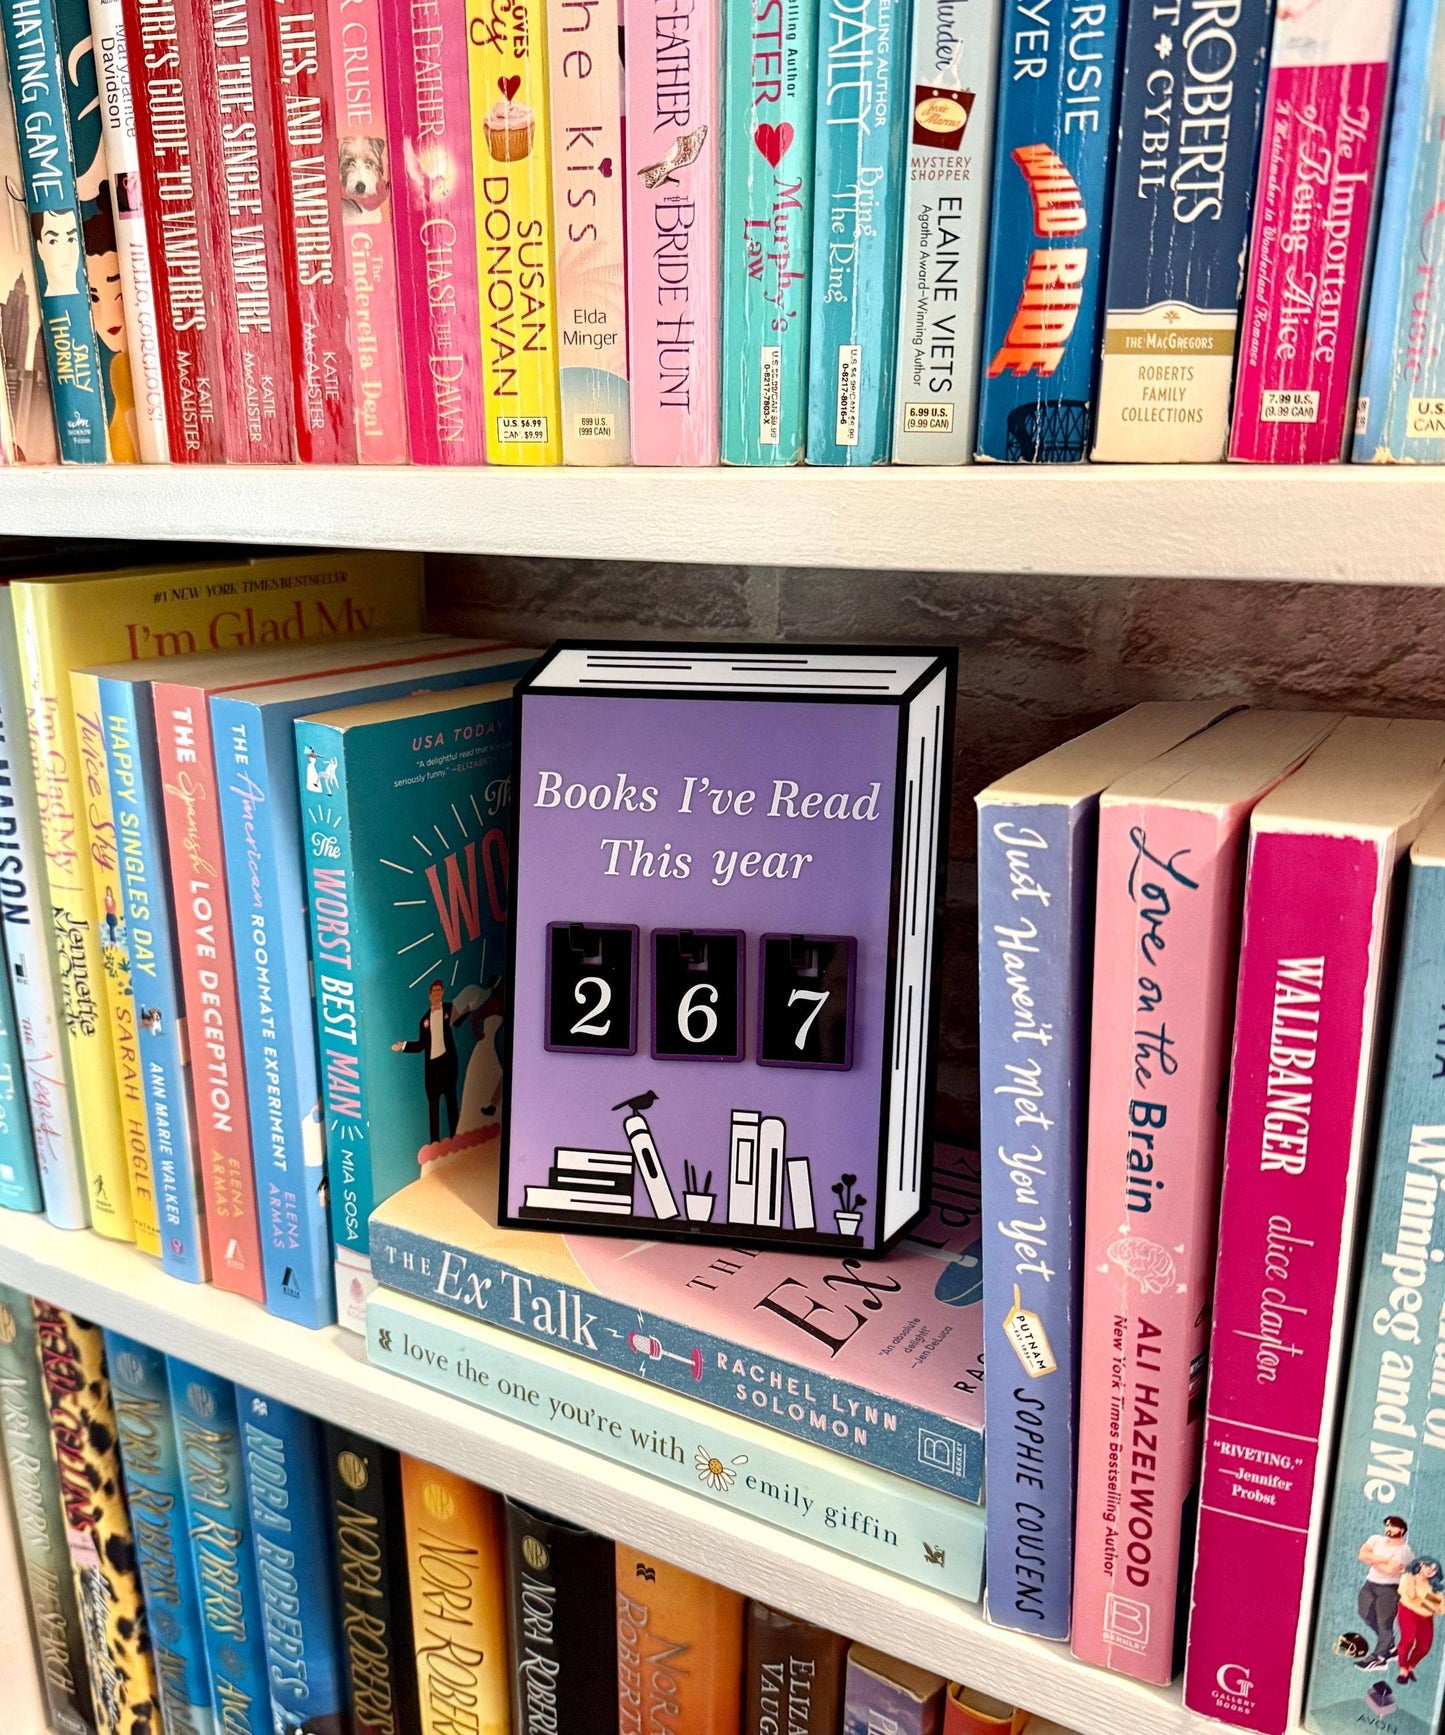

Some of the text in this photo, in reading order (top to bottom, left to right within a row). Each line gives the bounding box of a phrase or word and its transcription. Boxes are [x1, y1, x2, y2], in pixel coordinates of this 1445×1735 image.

[101, 37, 121, 129] Davidson
[341, 22, 373, 127] CRUSIE
[787, 48, 798, 98] Author
[875, 57, 889, 127] AUTHOR
[24, 110, 64, 203] GAME
[910, 169, 971, 181] SHOPPER
[911, 156, 972, 168] MYSTERY
[1137, 69, 1175, 199] CYBIL
[147, 78, 208, 332] GUIDE TO VAMPIRES
[217, 56, 272, 334] THE SINGLE VAMPIRE
[284, 95, 334, 287] AND VAMPIRES
[565, 125, 613, 242] kiss
[854, 166, 884, 237] Bring
[1010, 143, 1087, 237] WILD
[743, 219, 771, 282] Law
[764, 177, 805, 332] Murphy's
[824, 184, 860, 305] The Ring
[1276, 104, 1332, 362] of Being Alice
[1316, 104, 1370, 363] The Importance
[483, 177, 518, 397] DONOVAN
[517, 219, 548, 352] SUSAN
[573, 309, 607, 325] Elda
[654, 201, 695, 414] BRIDE HUNT
[913, 204, 934, 387] Agatha Author
[929, 197, 963, 393] ELAINE VIETS
[985, 247, 1088, 378] RIDE
[48, 310, 71, 386] THORNE
[72, 338, 94, 392] SALLY
[350, 232, 384, 437] Cinderella Deal
[420, 218, 465, 443] CHASE DAWN
[563, 331, 617, 350] Minger
[1125, 336, 1143, 348] THE
[1250, 305, 1267, 367] Romance
[196, 377, 214, 424] KATIE
[261, 376, 276, 418] KATIE
[322, 351, 341, 401] KATIE
[909, 408, 948, 418] 6.99 U.S.
[1121, 407, 1204, 423] COLLECTIONS
[1138, 366, 1194, 380] ROBERTS
[1142, 387, 1186, 402] FAMILY
[521, 419, 542, 428] $6.99
[524, 430, 544, 440] $9.99
[907, 418, 949, 429] (9.99 CAN)
[172, 571, 348, 600] NEW YORK TIMES BESTSELLER
[125, 601, 305, 660] I'm Glad
[393, 775, 426, 788] seriously
[412, 732, 445, 751] USA
[426, 749, 474, 767] delightful read
[76, 711, 118, 875] Twice Shy
[533, 770, 659, 813] Books
[677, 776, 756, 816] I've
[766, 779, 882, 821] Read
[106, 715, 157, 978] HAPPY SINGLES DAY
[600, 838, 813, 887] This year
[171, 706, 232, 1133] THE LOVE DECEPTION
[229, 724, 287, 1172] THE American ROOMMATE EXPERIMENT
[65, 910, 96, 1037] Jennette
[311, 831, 362, 1119] The WORST BEST MAN
[569, 976, 831, 1050] 2 6 7
[116, 1006, 141, 1101] SARAH
[993, 822, 1056, 1282] Just Haven't Met You Yet
[1126, 826, 1199, 1214] Love on the Brain
[1260, 955, 1325, 1175] WALLBANGER
[128, 1118, 152, 1202] HOGLE
[150, 1061, 181, 1226] ANN MARIE WALKER
[211, 1150, 230, 1218] ARMAS
[229, 1157, 244, 1218] ELENA
[268, 1183, 285, 1249] ARMAS
[284, 1191, 300, 1250] ELENA
[340, 1149, 360, 1241] MIA SOSA
[384, 1246, 598, 1351] THE Ex Talk
[892, 1317, 921, 1345] absolute
[925, 1326, 953, 1351] DeLuca
[1232, 1215, 1315, 1385] alice clayton
[1016, 1315, 1047, 1369] PUTNAM
[717, 1352, 897, 1432] RACHEL LYNN
[735, 1383, 867, 1446] SOLOMON
[1372, 1350, 1418, 1439] and
[180, 1416, 230, 1510] NORA
[402, 1333, 898, 1546] love the one you're with emily giffin
[955, 1440, 965, 1477] BERKLEY
[1013, 1387, 1045, 1490] SOPHIE
[1103, 1315, 1127, 1577] New York Times Bestselling Author
[1126, 1317, 1162, 1588] ALI HAZELWOOD
[1363, 1440, 1414, 1504] Me
[1231, 1483, 1278, 1506] Probst
[188, 1511, 247, 1642] ROBERTS
[244, 1421, 310, 1698] NORA ROBERTS
[336, 1500, 384, 1598] NORA
[417, 1527, 480, 1627] NORA
[1015, 1501, 1046, 1620] COUSENS
[521, 1572, 557, 1645] NORA
[1211, 1690, 1256, 1708] GALLERY
[1216, 1699, 1250, 1714] BOOKS
[1356, 1714, 1398, 1734] AVON
